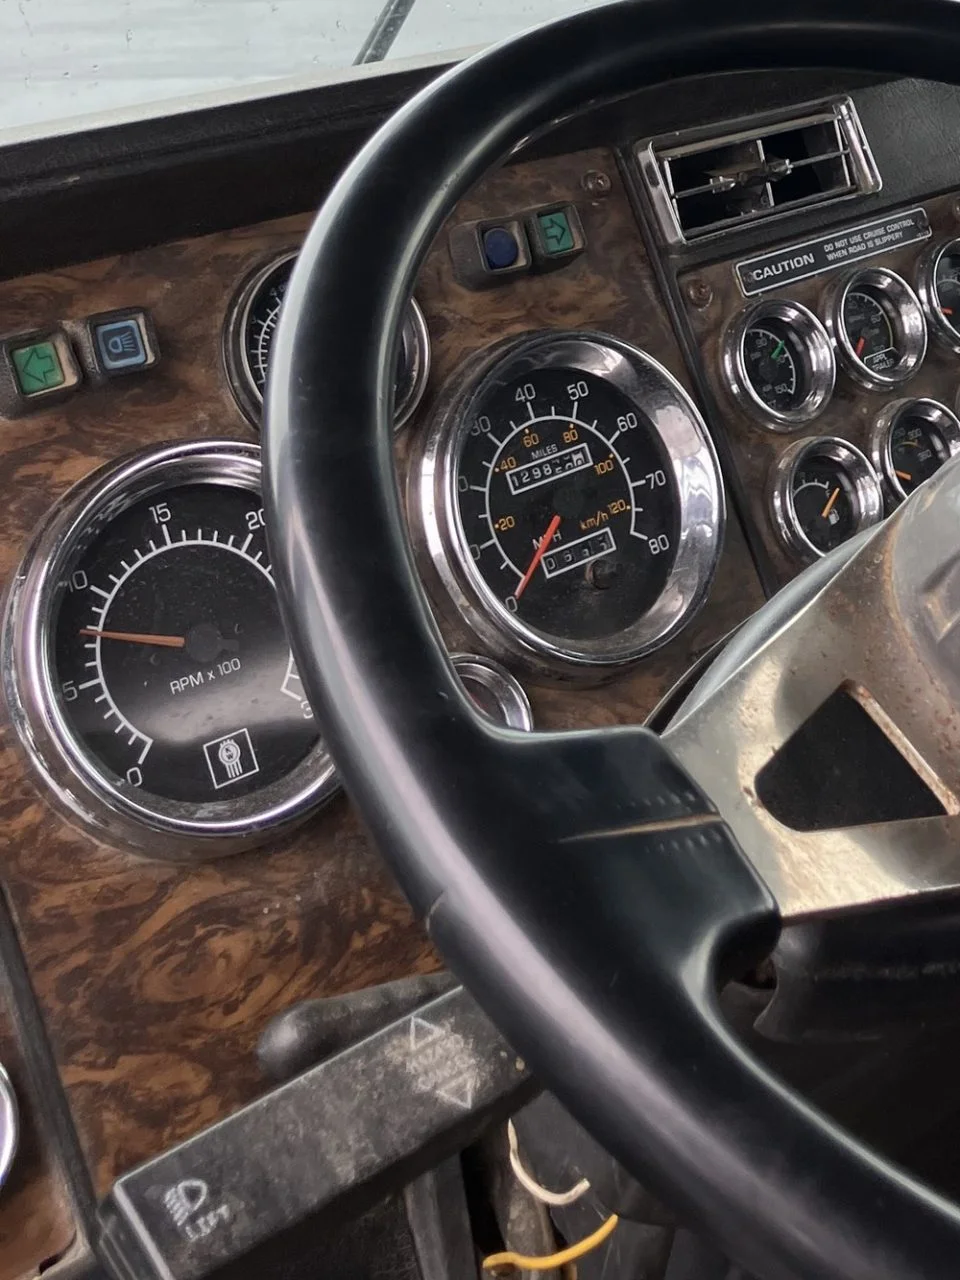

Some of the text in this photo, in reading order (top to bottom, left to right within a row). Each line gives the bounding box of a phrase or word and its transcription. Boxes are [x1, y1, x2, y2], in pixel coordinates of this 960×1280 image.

[823, 219, 915, 252] DO NOT USE CRUISE CONTROL
[826, 249, 848, 261] WHEN
[848, 244, 866, 254] ROAD
[867, 240, 875, 248] IS
[874, 231, 904, 246] SLIPPERY
[752, 252, 815, 281] CAUTION
[515, 383, 536, 402] 40
[567, 381, 590, 401] 50
[471, 416, 491, 436] 30
[617, 412, 638, 433] 60
[523, 433, 540, 448] 60
[563, 429, 579, 444] 80
[531, 443, 558, 459] MILES
[500, 456, 517, 471] 40
[594, 459, 614, 476] 100
[458, 476, 469, 492] 0
[645, 470, 666, 490] 70
[149, 503, 171, 524] 15
[607, 499, 626, 515] 120
[499, 515, 515, 532] 20
[579, 511, 609, 531] km/h
[532, 529, 562, 551] MH
[648, 534, 670, 555] 80
[68, 571, 88, 593] 10
[505, 595, 519, 612] 0
[170, 672, 204, 695] RPM
[217, 657, 242, 676] 100
[62, 681, 78, 701] 5
[126, 767, 143, 787] 0
